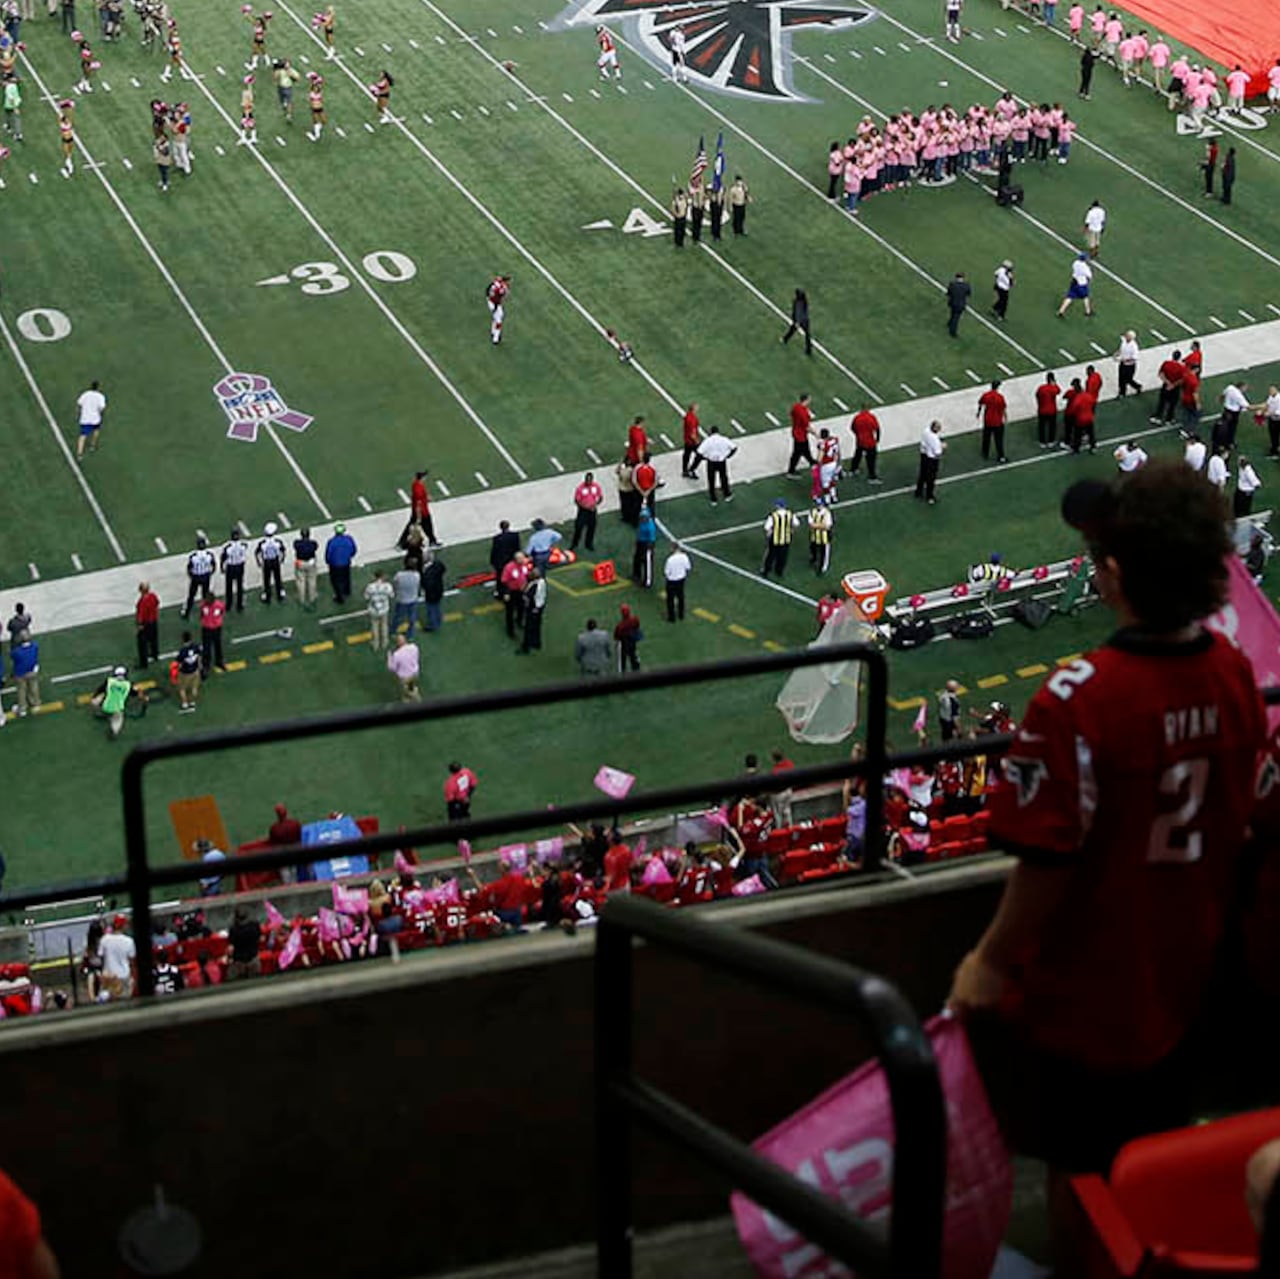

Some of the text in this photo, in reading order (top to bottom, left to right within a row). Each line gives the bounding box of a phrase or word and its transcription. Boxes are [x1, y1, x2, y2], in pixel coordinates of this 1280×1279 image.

[289, 250, 418, 296] 30
[232, 399, 282, 422] NFL
[1045, 657, 1097, 701] 2
[1163, 701, 1220, 745] RYAN
[1146, 757, 1210, 865] 2
